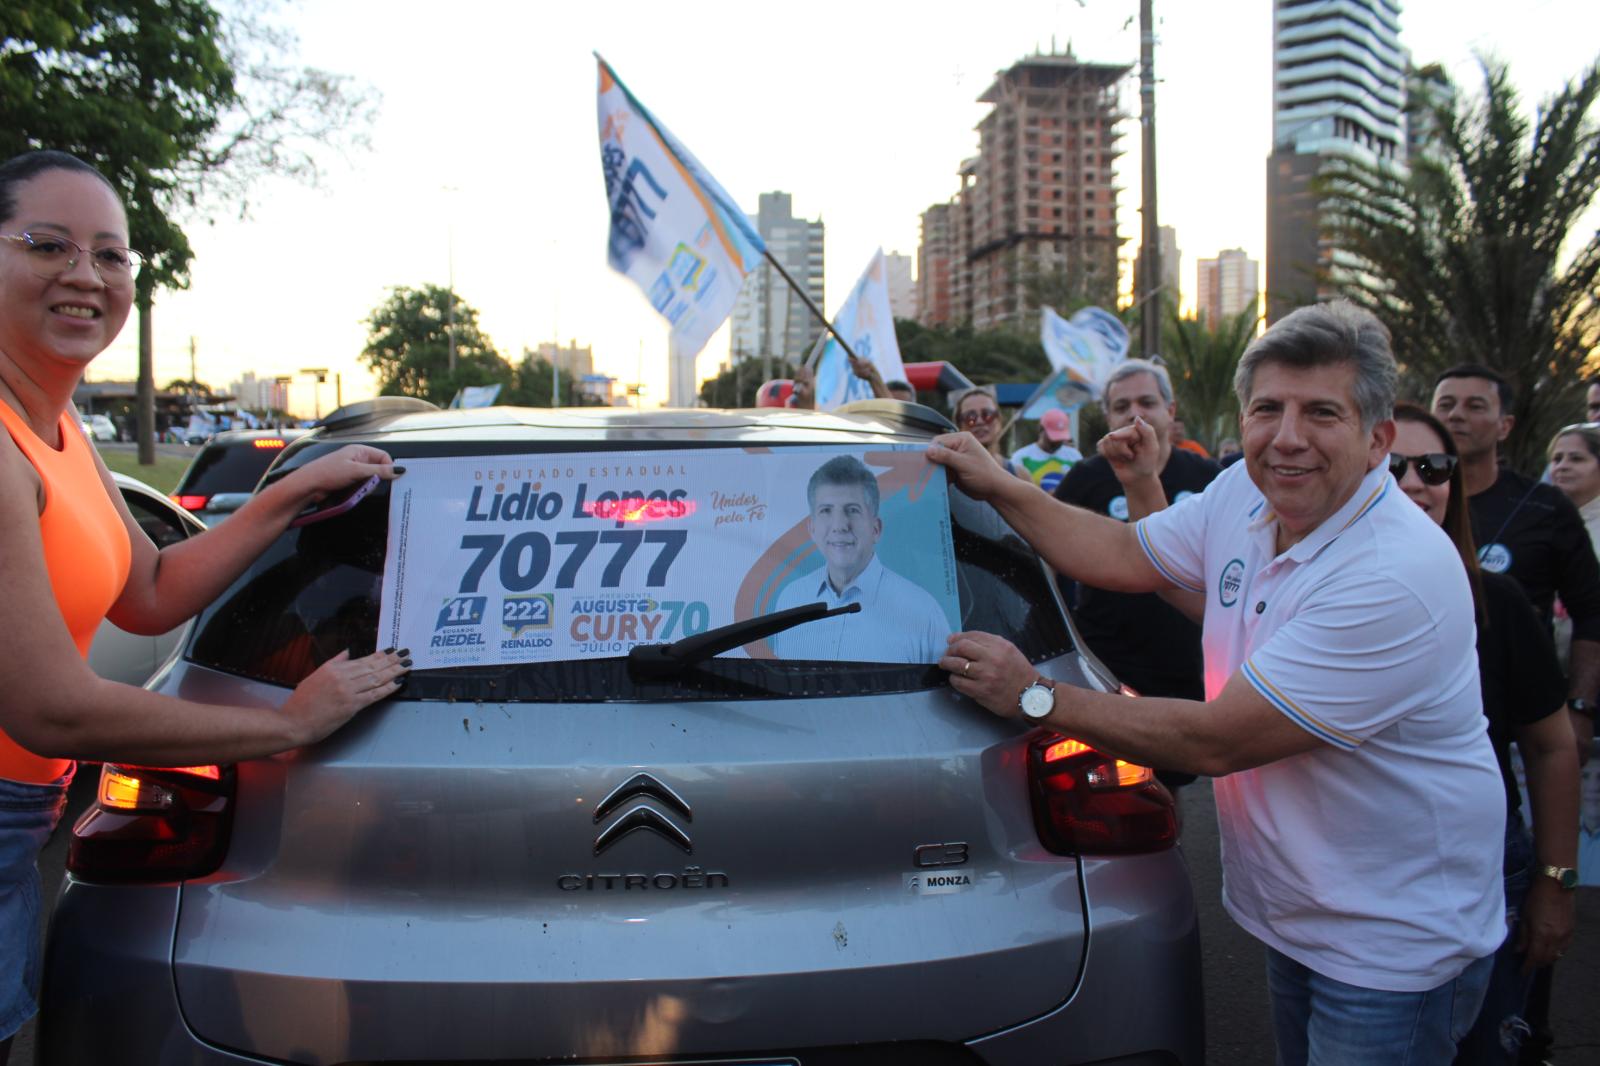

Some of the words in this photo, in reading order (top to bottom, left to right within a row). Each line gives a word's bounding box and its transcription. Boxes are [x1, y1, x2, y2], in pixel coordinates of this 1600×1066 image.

[475, 468, 574, 481] DEPUTADO
[589, 465, 688, 477] ESTADUAL
[465, 481, 564, 522] Lidio
[572, 483, 688, 529] Lopes
[711, 490, 758, 511] Unidos
[458, 530, 688, 594] 70777
[447, 599, 474, 621] 11
[503, 600, 546, 621] 222
[570, 599, 649, 614] AUGUSTO
[570, 613, 662, 642] CURY
[660, 601, 710, 640] 70
[430, 633, 485, 648] RIEDEL
[501, 638, 553, 649] REINALDO
[579, 639, 622, 653] JÚLIO
[913, 841, 969, 869] C3
[927, 875, 971, 887] MONZA
